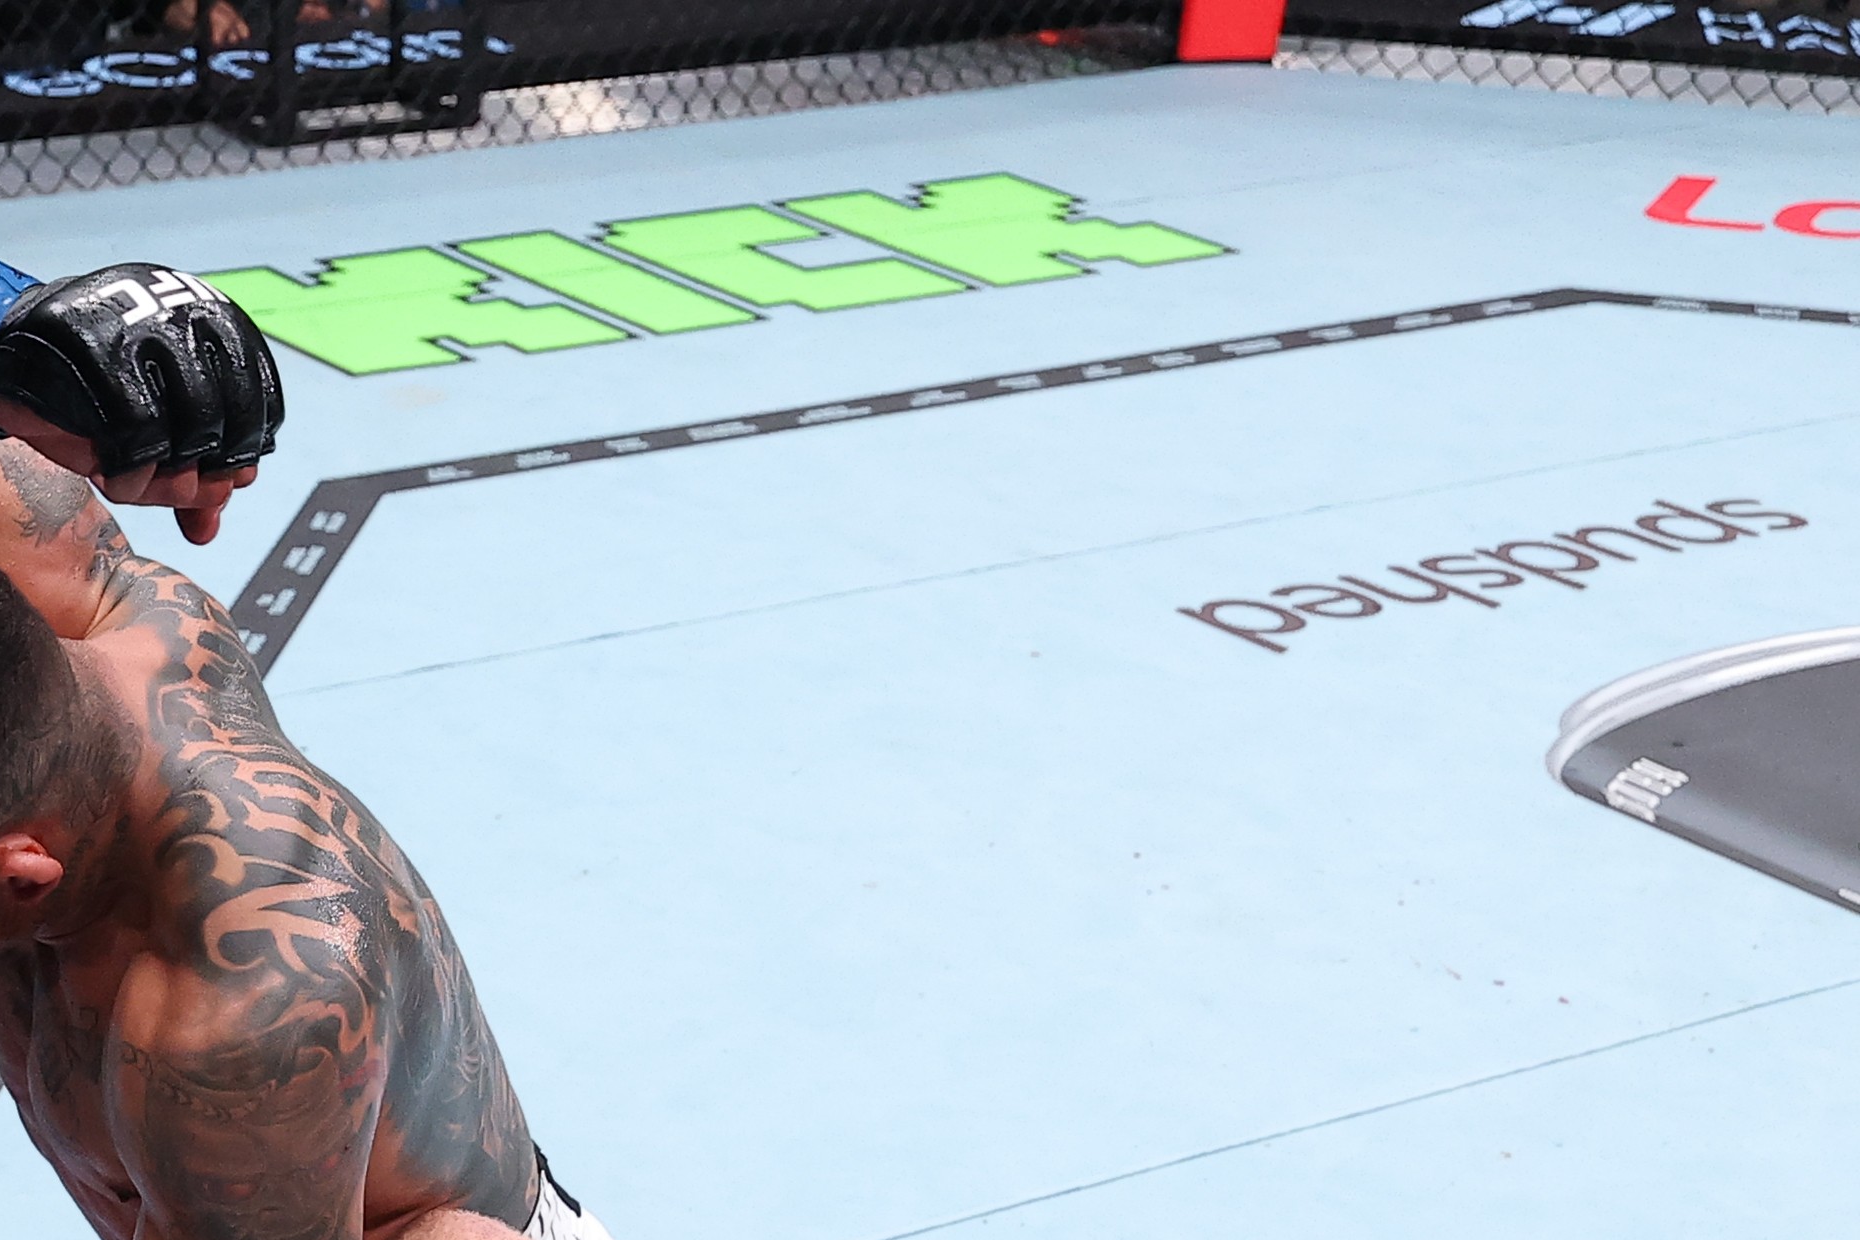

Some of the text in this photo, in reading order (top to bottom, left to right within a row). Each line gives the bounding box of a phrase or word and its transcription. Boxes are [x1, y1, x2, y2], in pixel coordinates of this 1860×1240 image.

[97, 267, 230, 326] UFC
[196, 173, 1233, 377] KICK
[1176, 498, 1811, 653] spudshed
